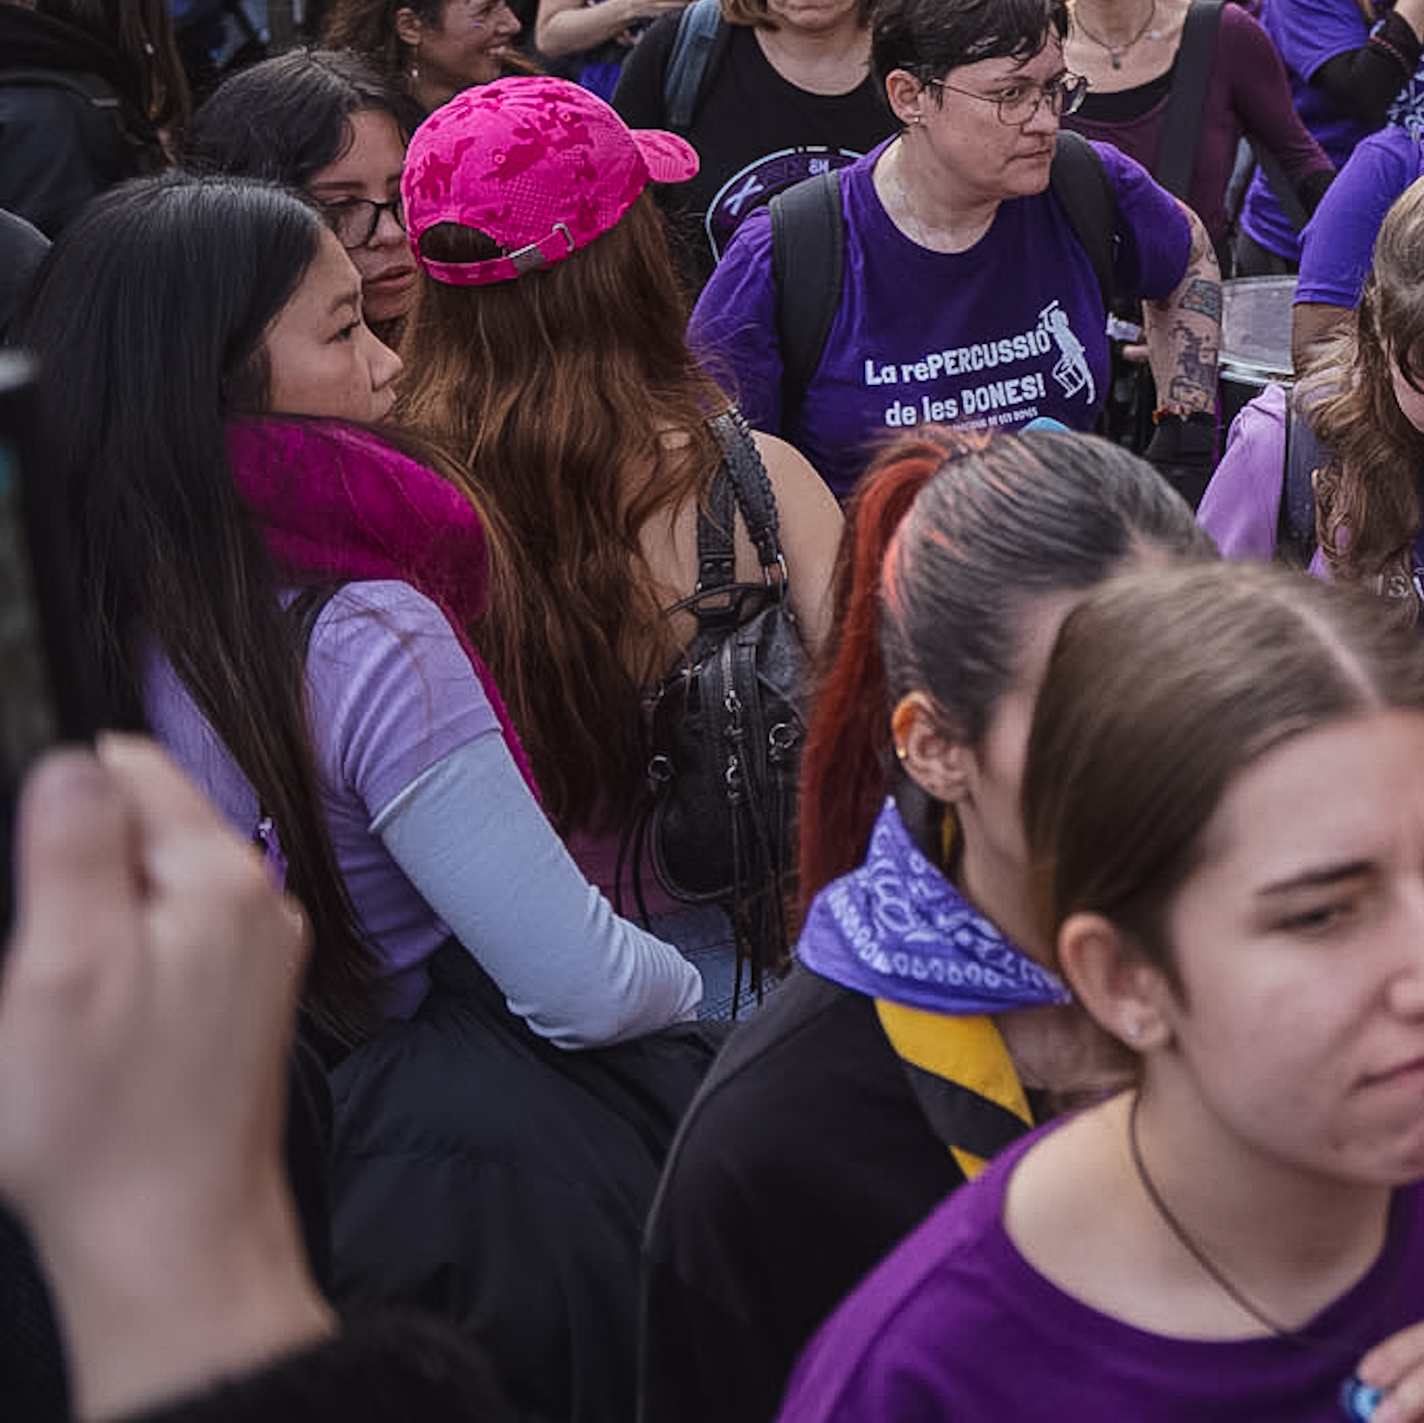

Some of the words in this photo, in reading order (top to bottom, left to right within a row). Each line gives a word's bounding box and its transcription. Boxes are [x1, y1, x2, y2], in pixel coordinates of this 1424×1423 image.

[864, 359, 898, 386] La
[900, 322, 1052, 383] rePERCUSSIÓ
[885, 400, 918, 427] de
[922, 396, 959, 422] les
[961, 372, 1047, 415] DONES!
